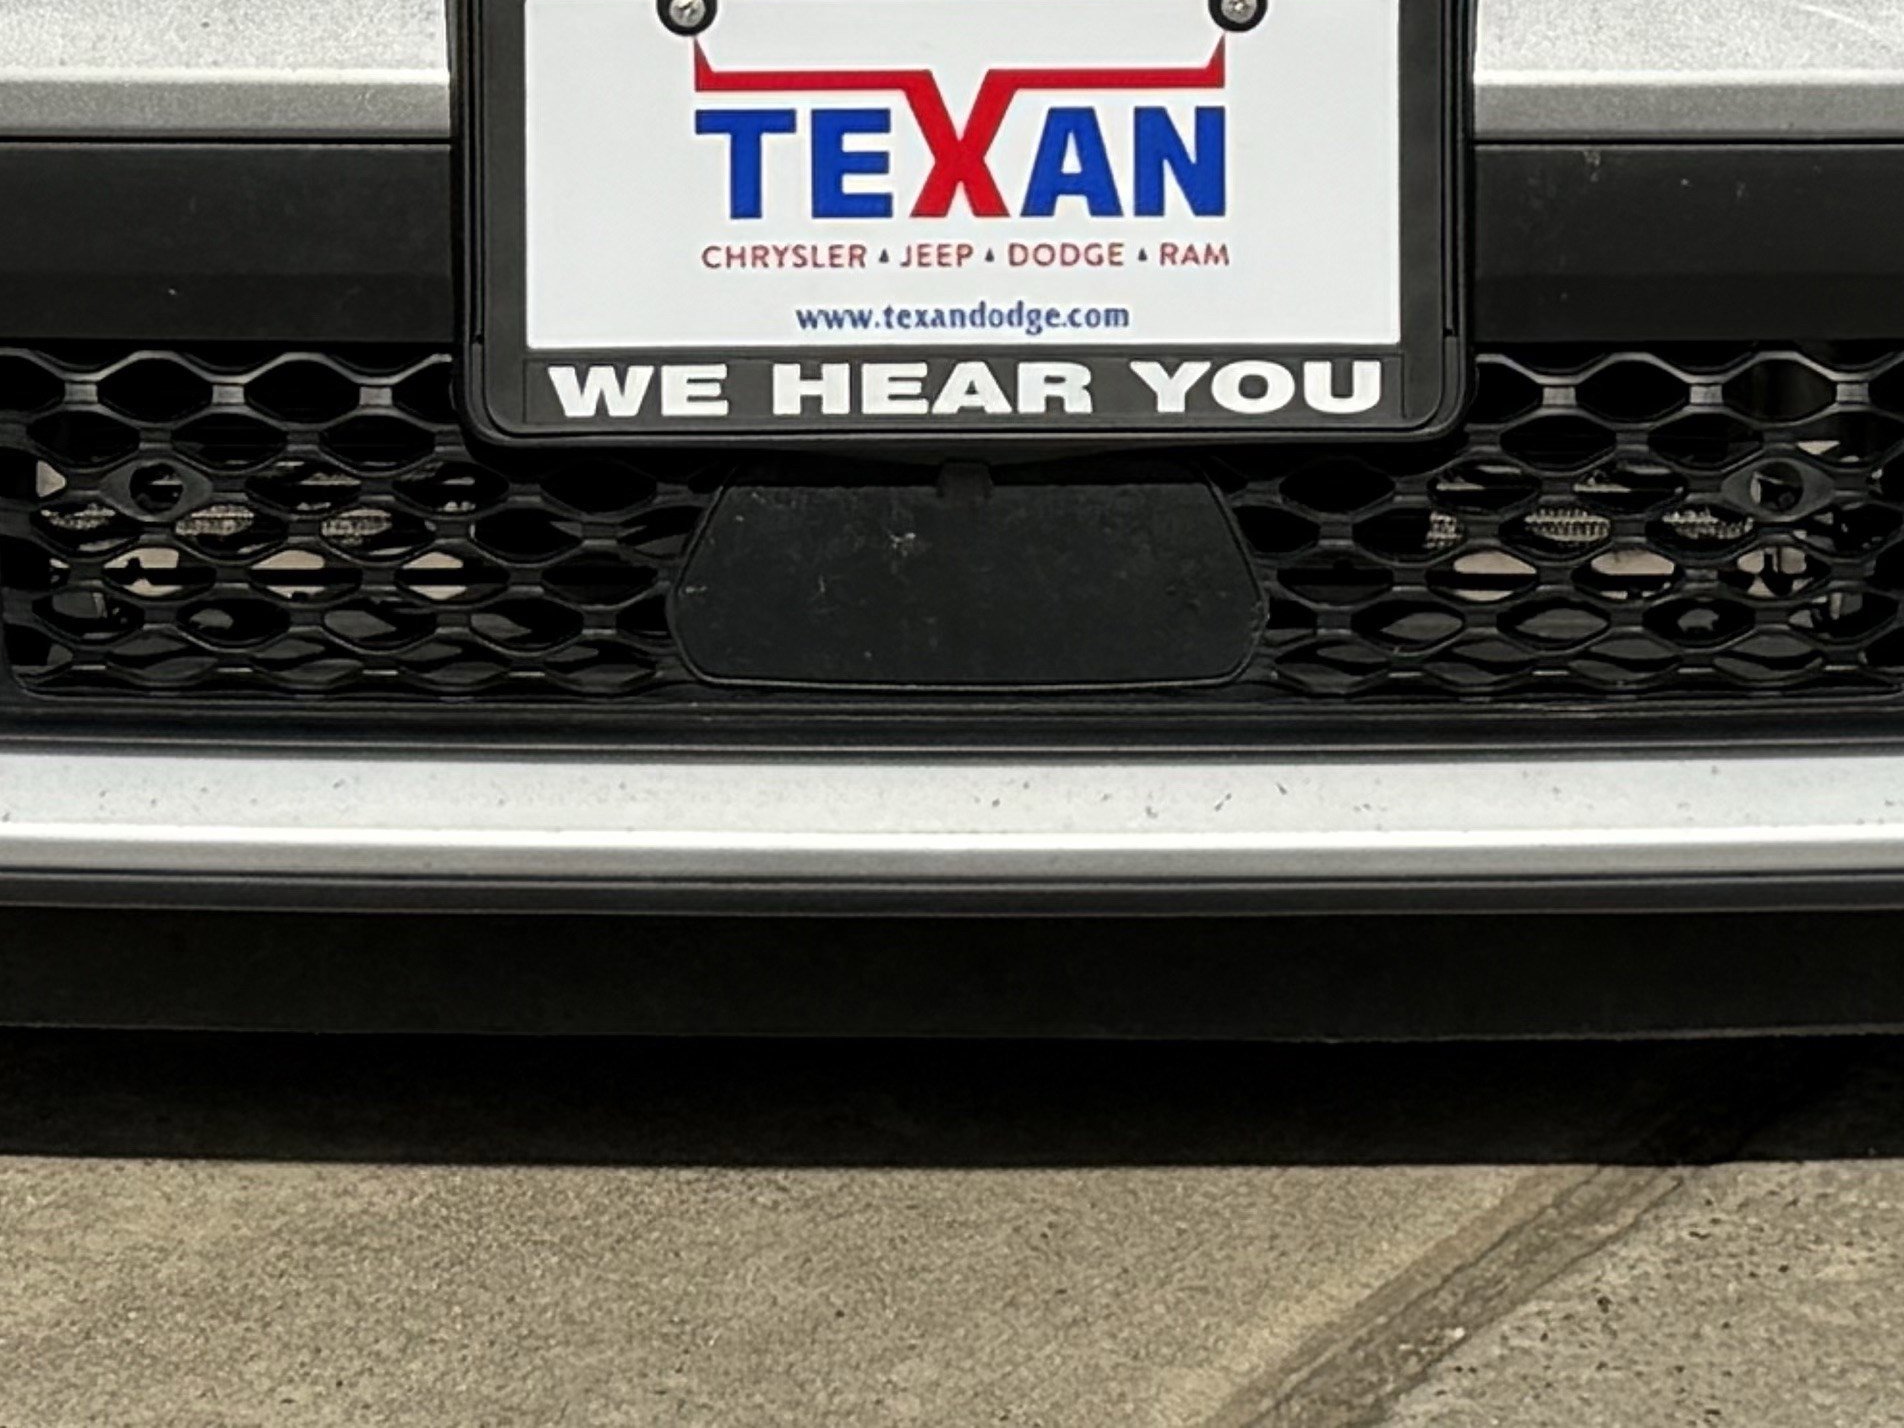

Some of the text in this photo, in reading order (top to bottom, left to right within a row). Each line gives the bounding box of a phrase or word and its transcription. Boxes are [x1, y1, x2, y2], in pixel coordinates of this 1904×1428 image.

[696, 64, 1226, 220] TEXAN
[701, 242, 1230, 269] CHRYSLER JEEP DODGE RAM
[795, 299, 1130, 337] www.texandodge.com
[547, 359, 1382, 419] WE HEAR YOU
